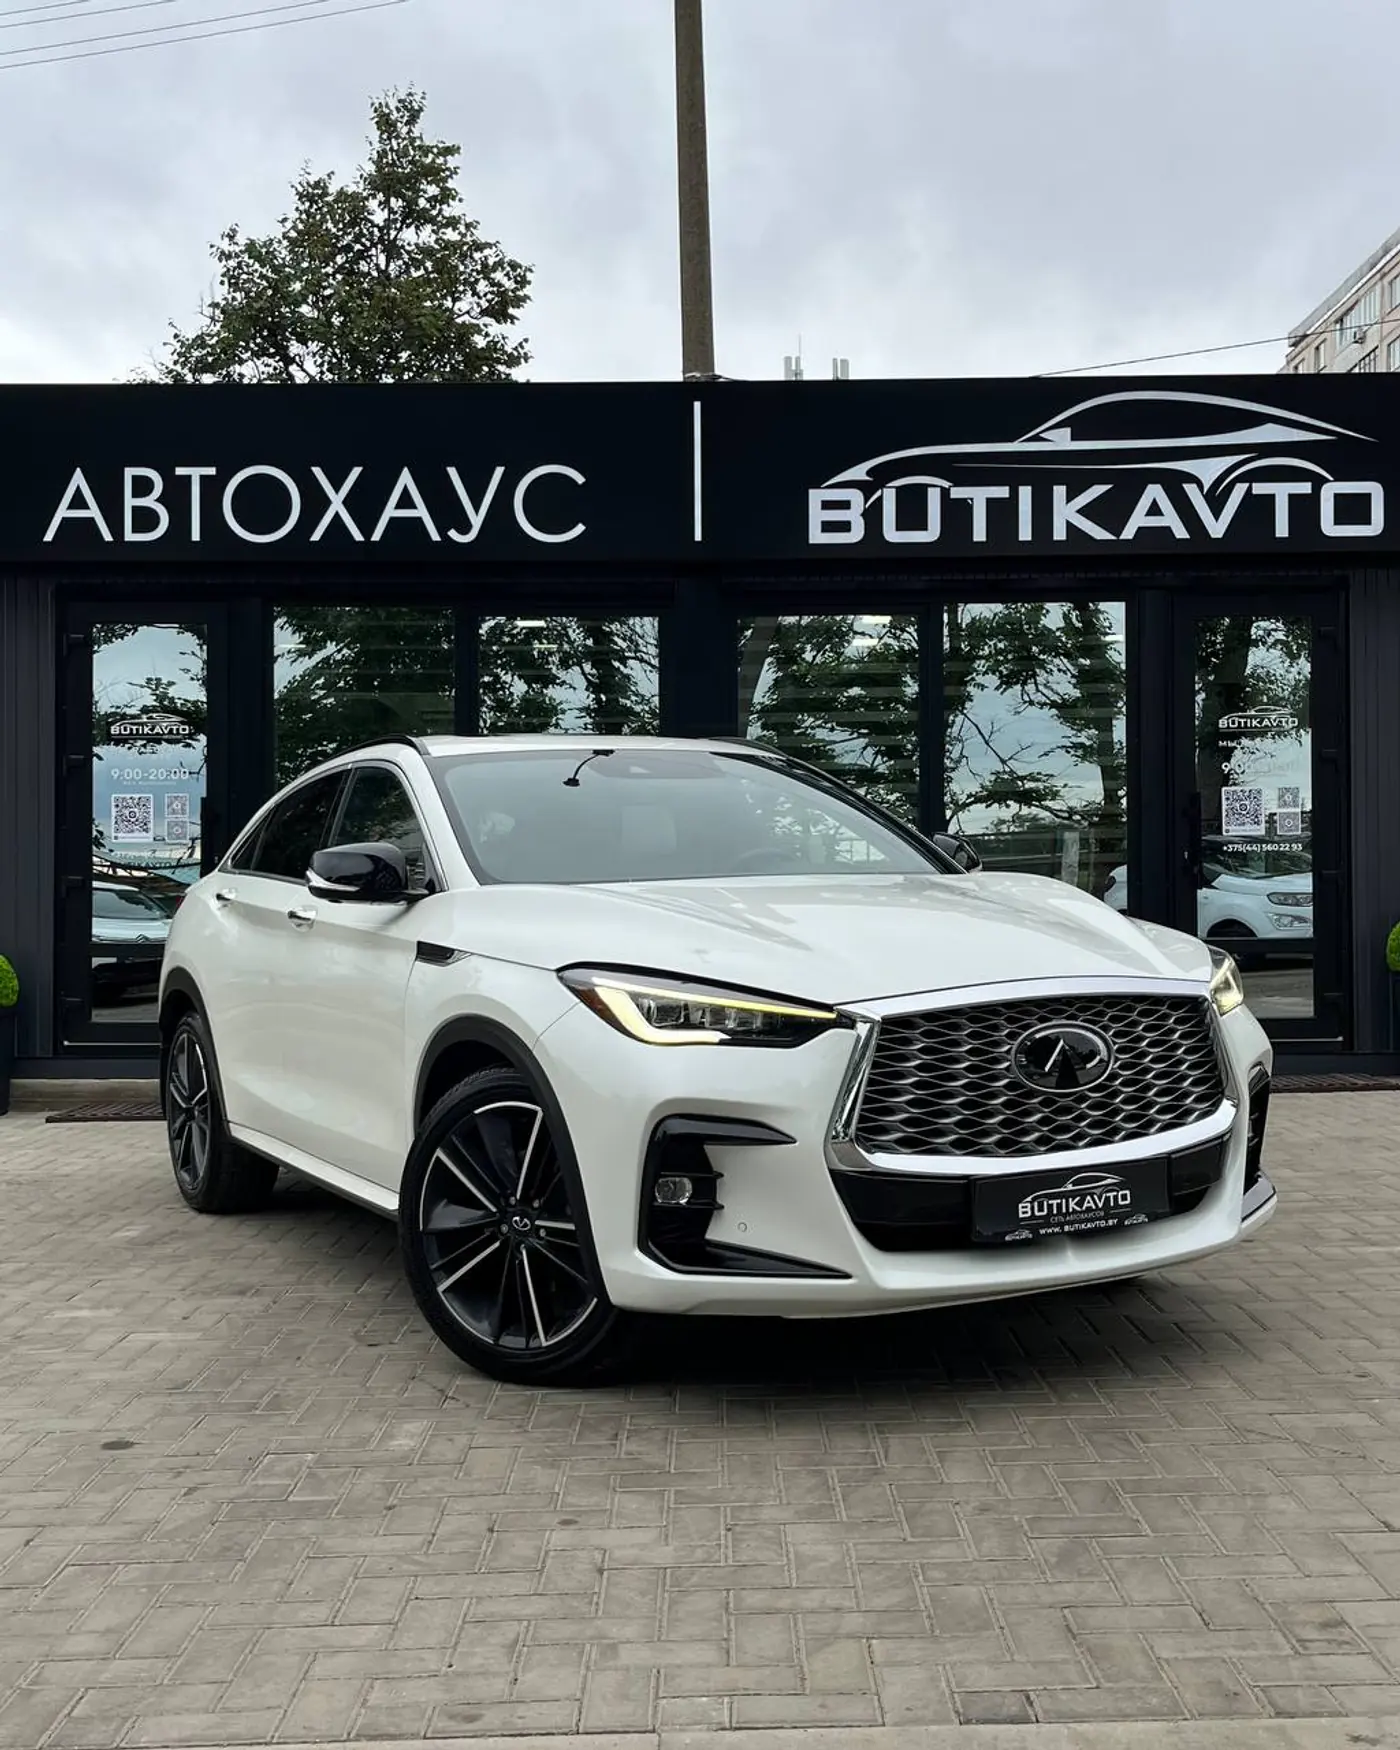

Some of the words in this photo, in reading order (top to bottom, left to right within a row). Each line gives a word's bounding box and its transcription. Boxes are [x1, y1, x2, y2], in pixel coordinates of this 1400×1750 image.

[42, 464, 587, 544] АВТОХАУС
[807, 480, 1386, 544] BUTIKAVTO
[110, 724, 190, 735] BUTIKAVTO
[1218, 717, 1299, 729] BUTIKAVTO
[111, 768, 190, 780] 9:00-20:00
[1018, 1190, 1131, 1219] BUTIKAVTO
